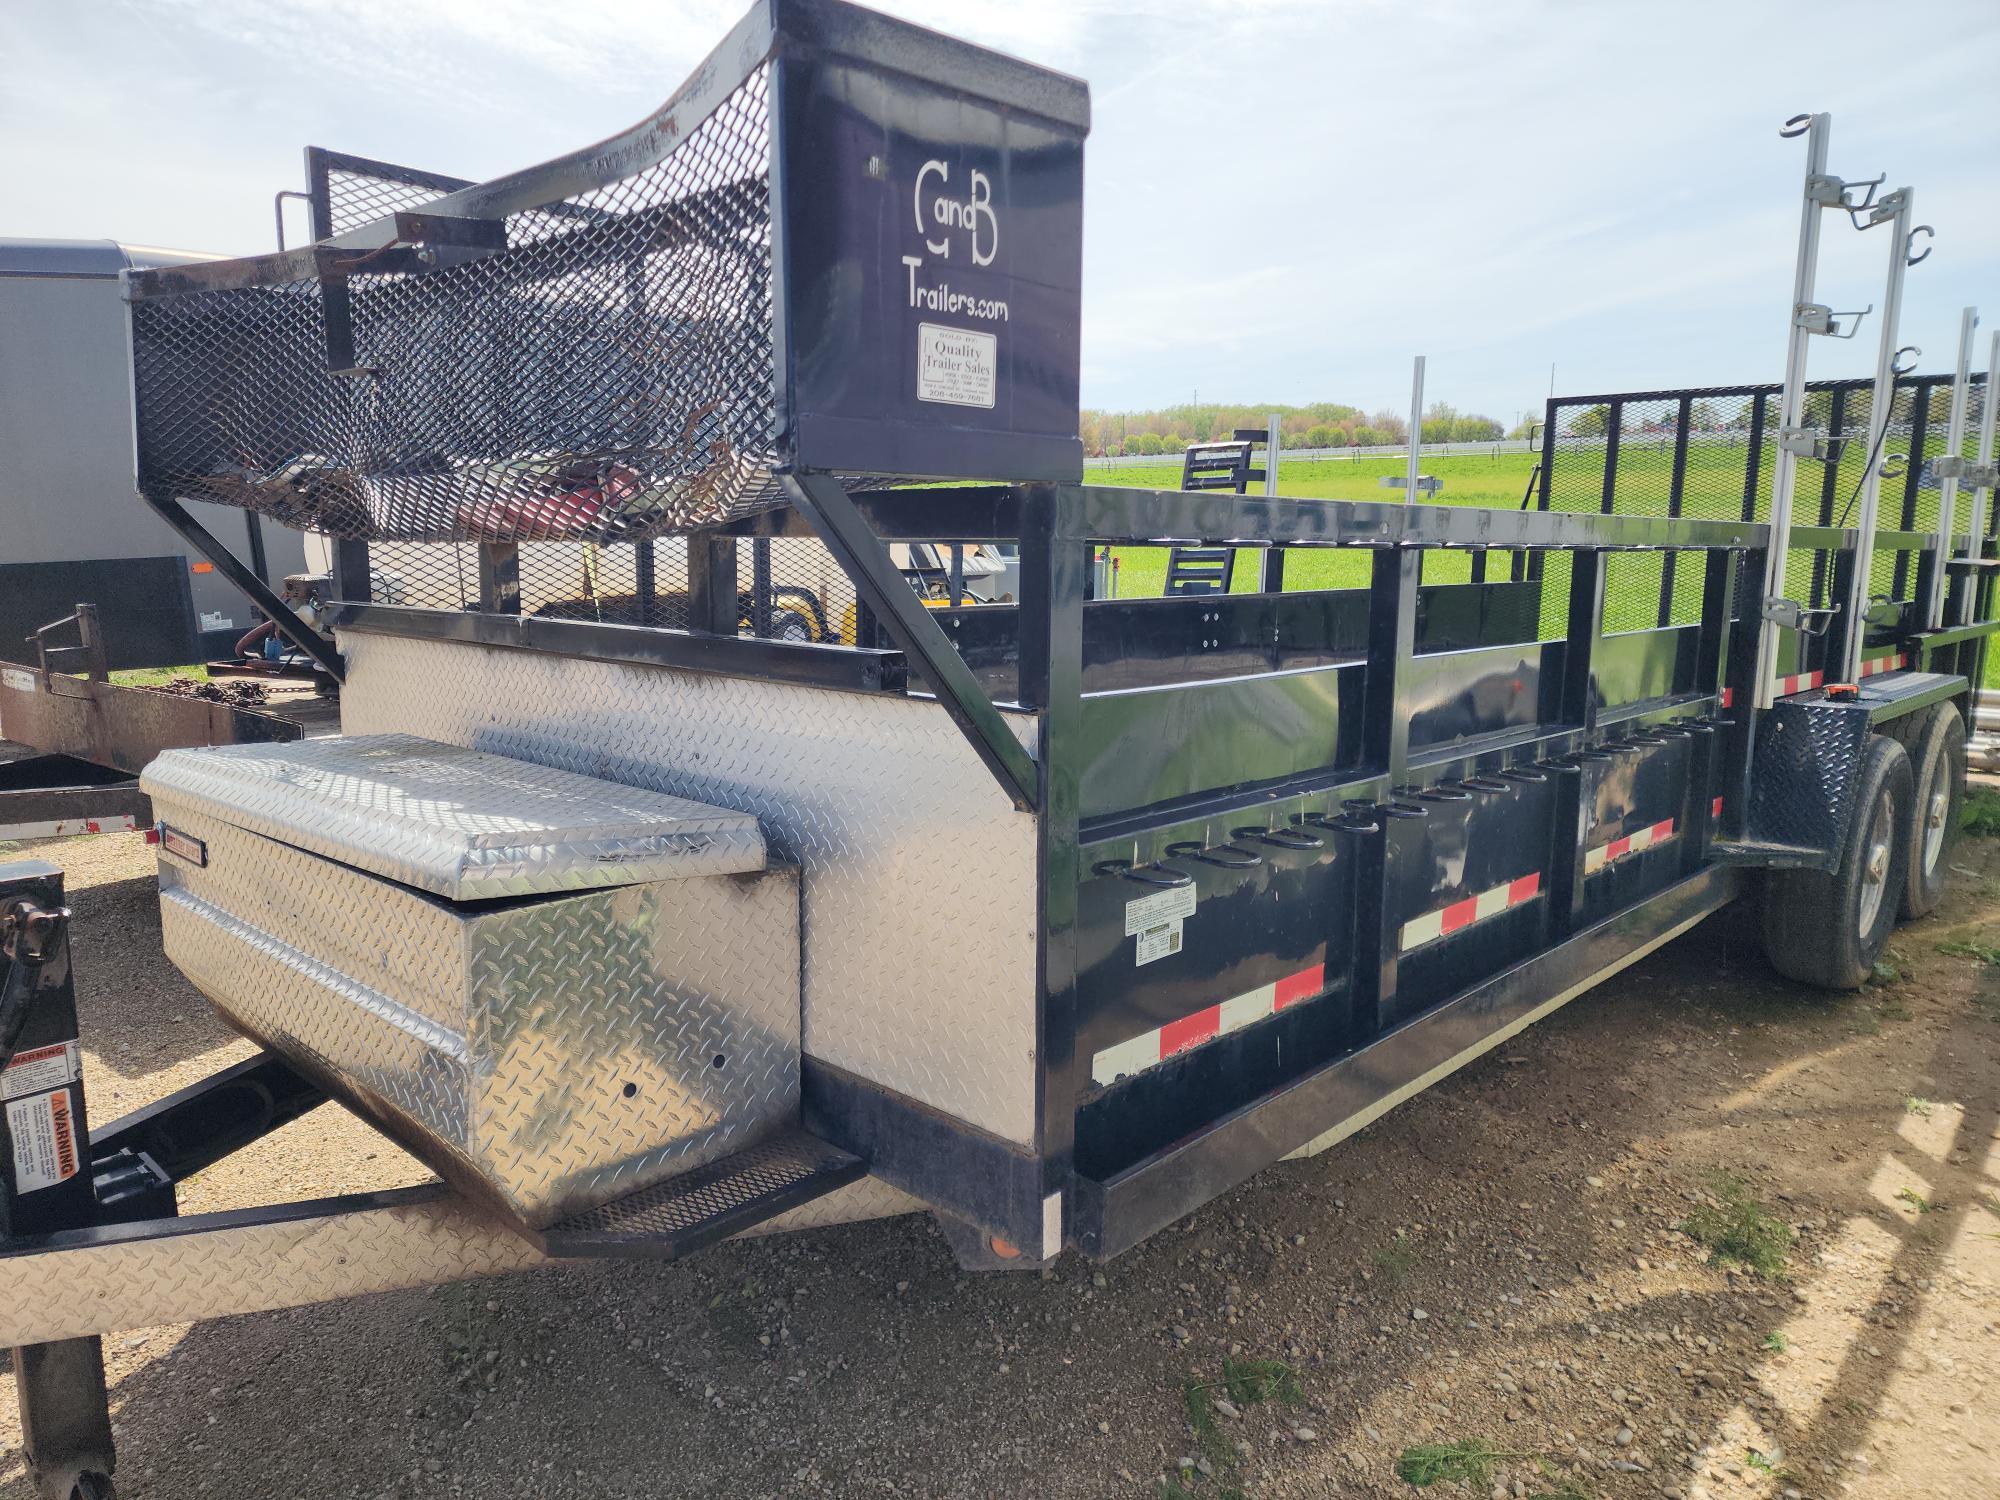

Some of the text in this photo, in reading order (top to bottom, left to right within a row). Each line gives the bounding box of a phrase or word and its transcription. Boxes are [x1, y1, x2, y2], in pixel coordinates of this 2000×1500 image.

[902, 255, 1009, 322] Trailers.com
[935, 340, 983, 362] Quality
[925, 354, 990, 376] Trailer Sales
[12, 1047, 63, 1065] WARNING
[54, 1108, 75, 1174] WARNING
